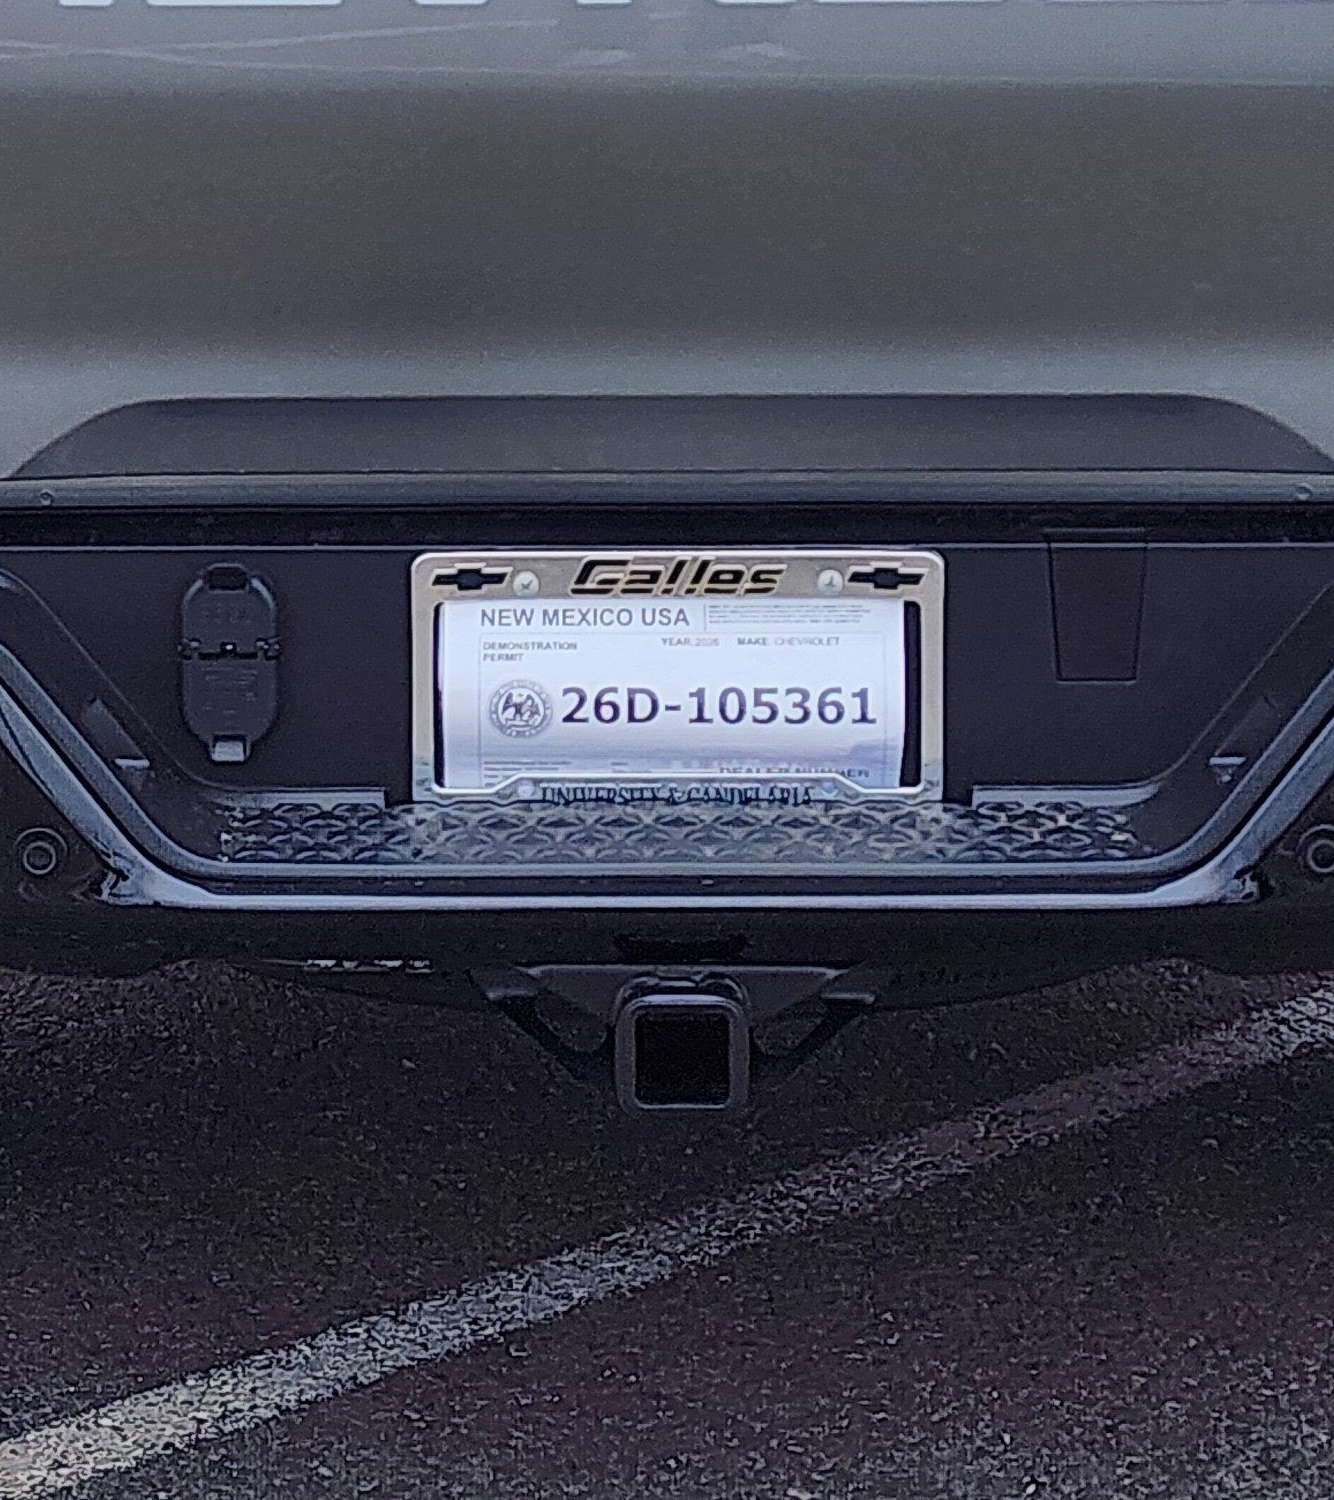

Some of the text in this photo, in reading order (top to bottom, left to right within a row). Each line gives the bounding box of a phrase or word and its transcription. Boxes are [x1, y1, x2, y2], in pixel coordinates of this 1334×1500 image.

[569, 556, 789, 597] Galles
[481, 608, 534, 626] NEW
[542, 608, 633, 626] MEXICO
[641, 607, 690, 626] USA
[483, 641, 577, 651] DEMONSTRATION
[774, 636, 840, 646] CHEVROLET
[483, 653, 523, 662] PERMIT
[561, 686, 877, 725] 26D-105361
